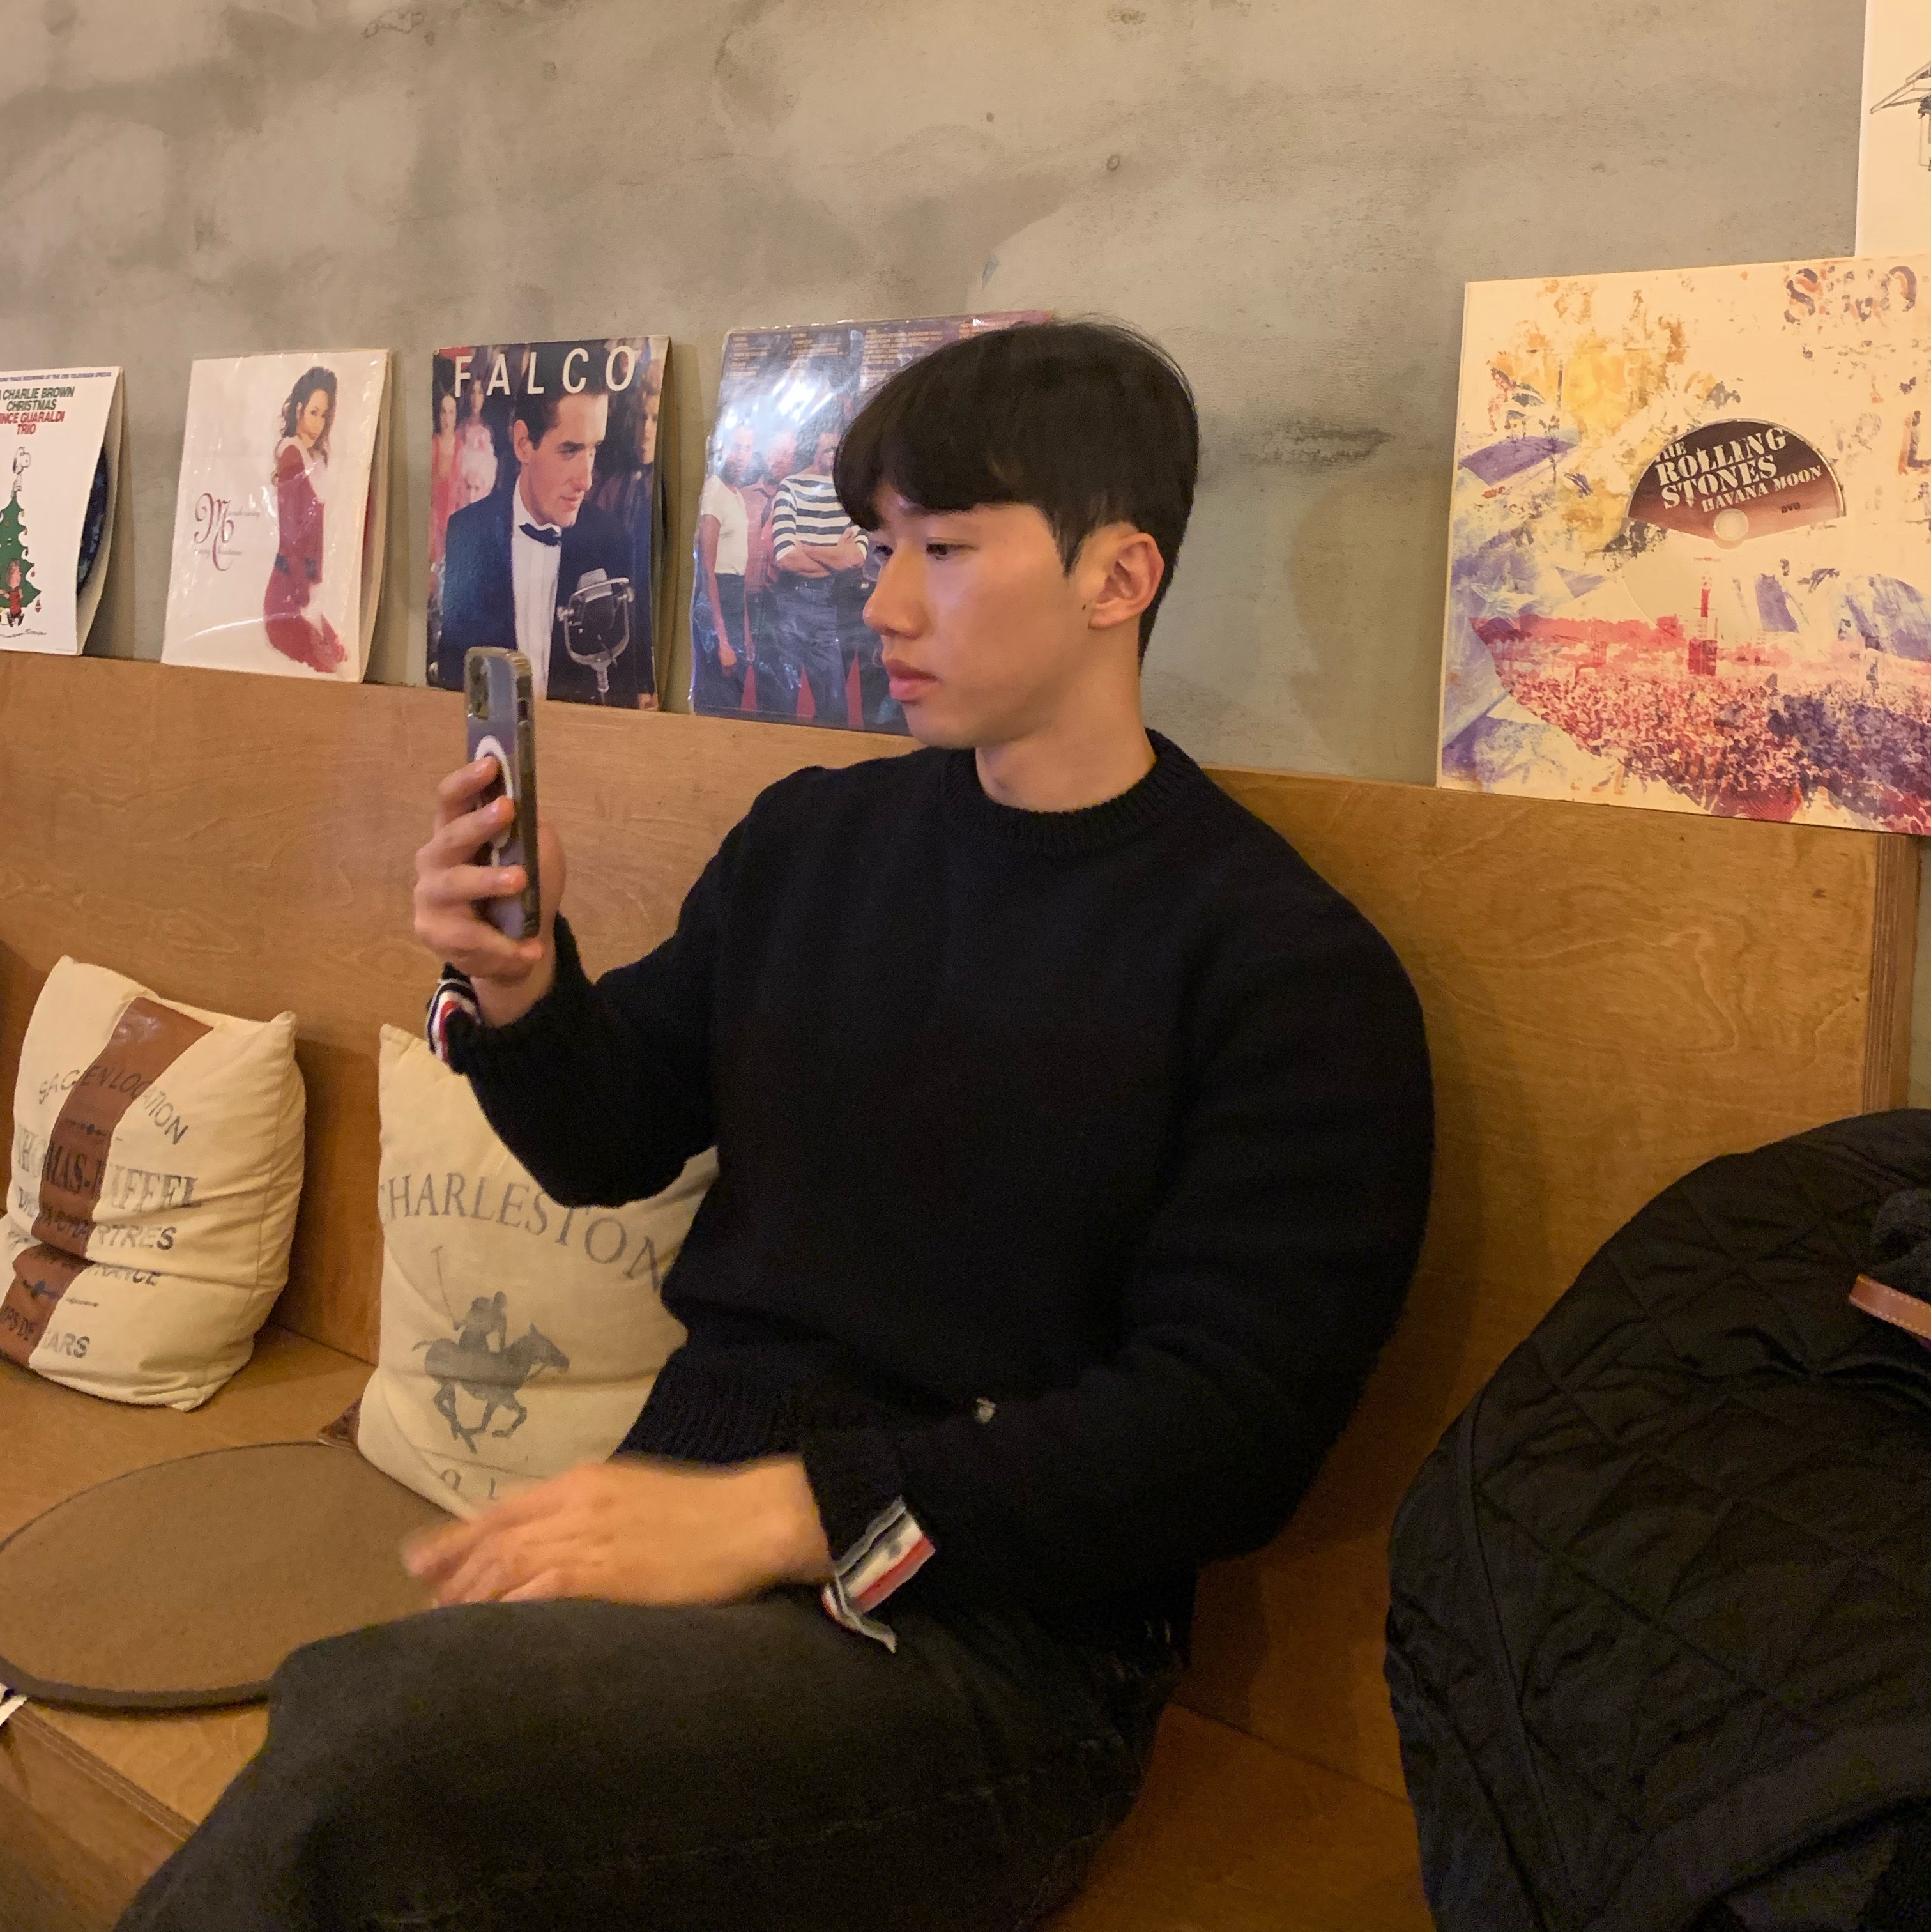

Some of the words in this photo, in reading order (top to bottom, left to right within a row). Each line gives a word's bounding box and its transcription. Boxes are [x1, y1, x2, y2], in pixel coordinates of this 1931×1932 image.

[454, 346, 636, 398] FALCO
[3, 388, 40, 400] CHARLIE
[41, 386, 75, 399] BROWN
[6, 399, 57, 411] CHRISTMAS
[0, 413, 19, 424] INCE
[20, 411, 66, 423] GUARALDI
[17, 424, 36, 435] TRIO
[1655, 427, 1787, 486] ROLLING
[1661, 454, 1778, 509] STONES
[1701, 482, 1769, 512] HAVANA
[1772, 465, 1822, 492] MOON
[1780, 502, 1801, 514] DVD
[380, 1172, 666, 1292] HARLESTON
